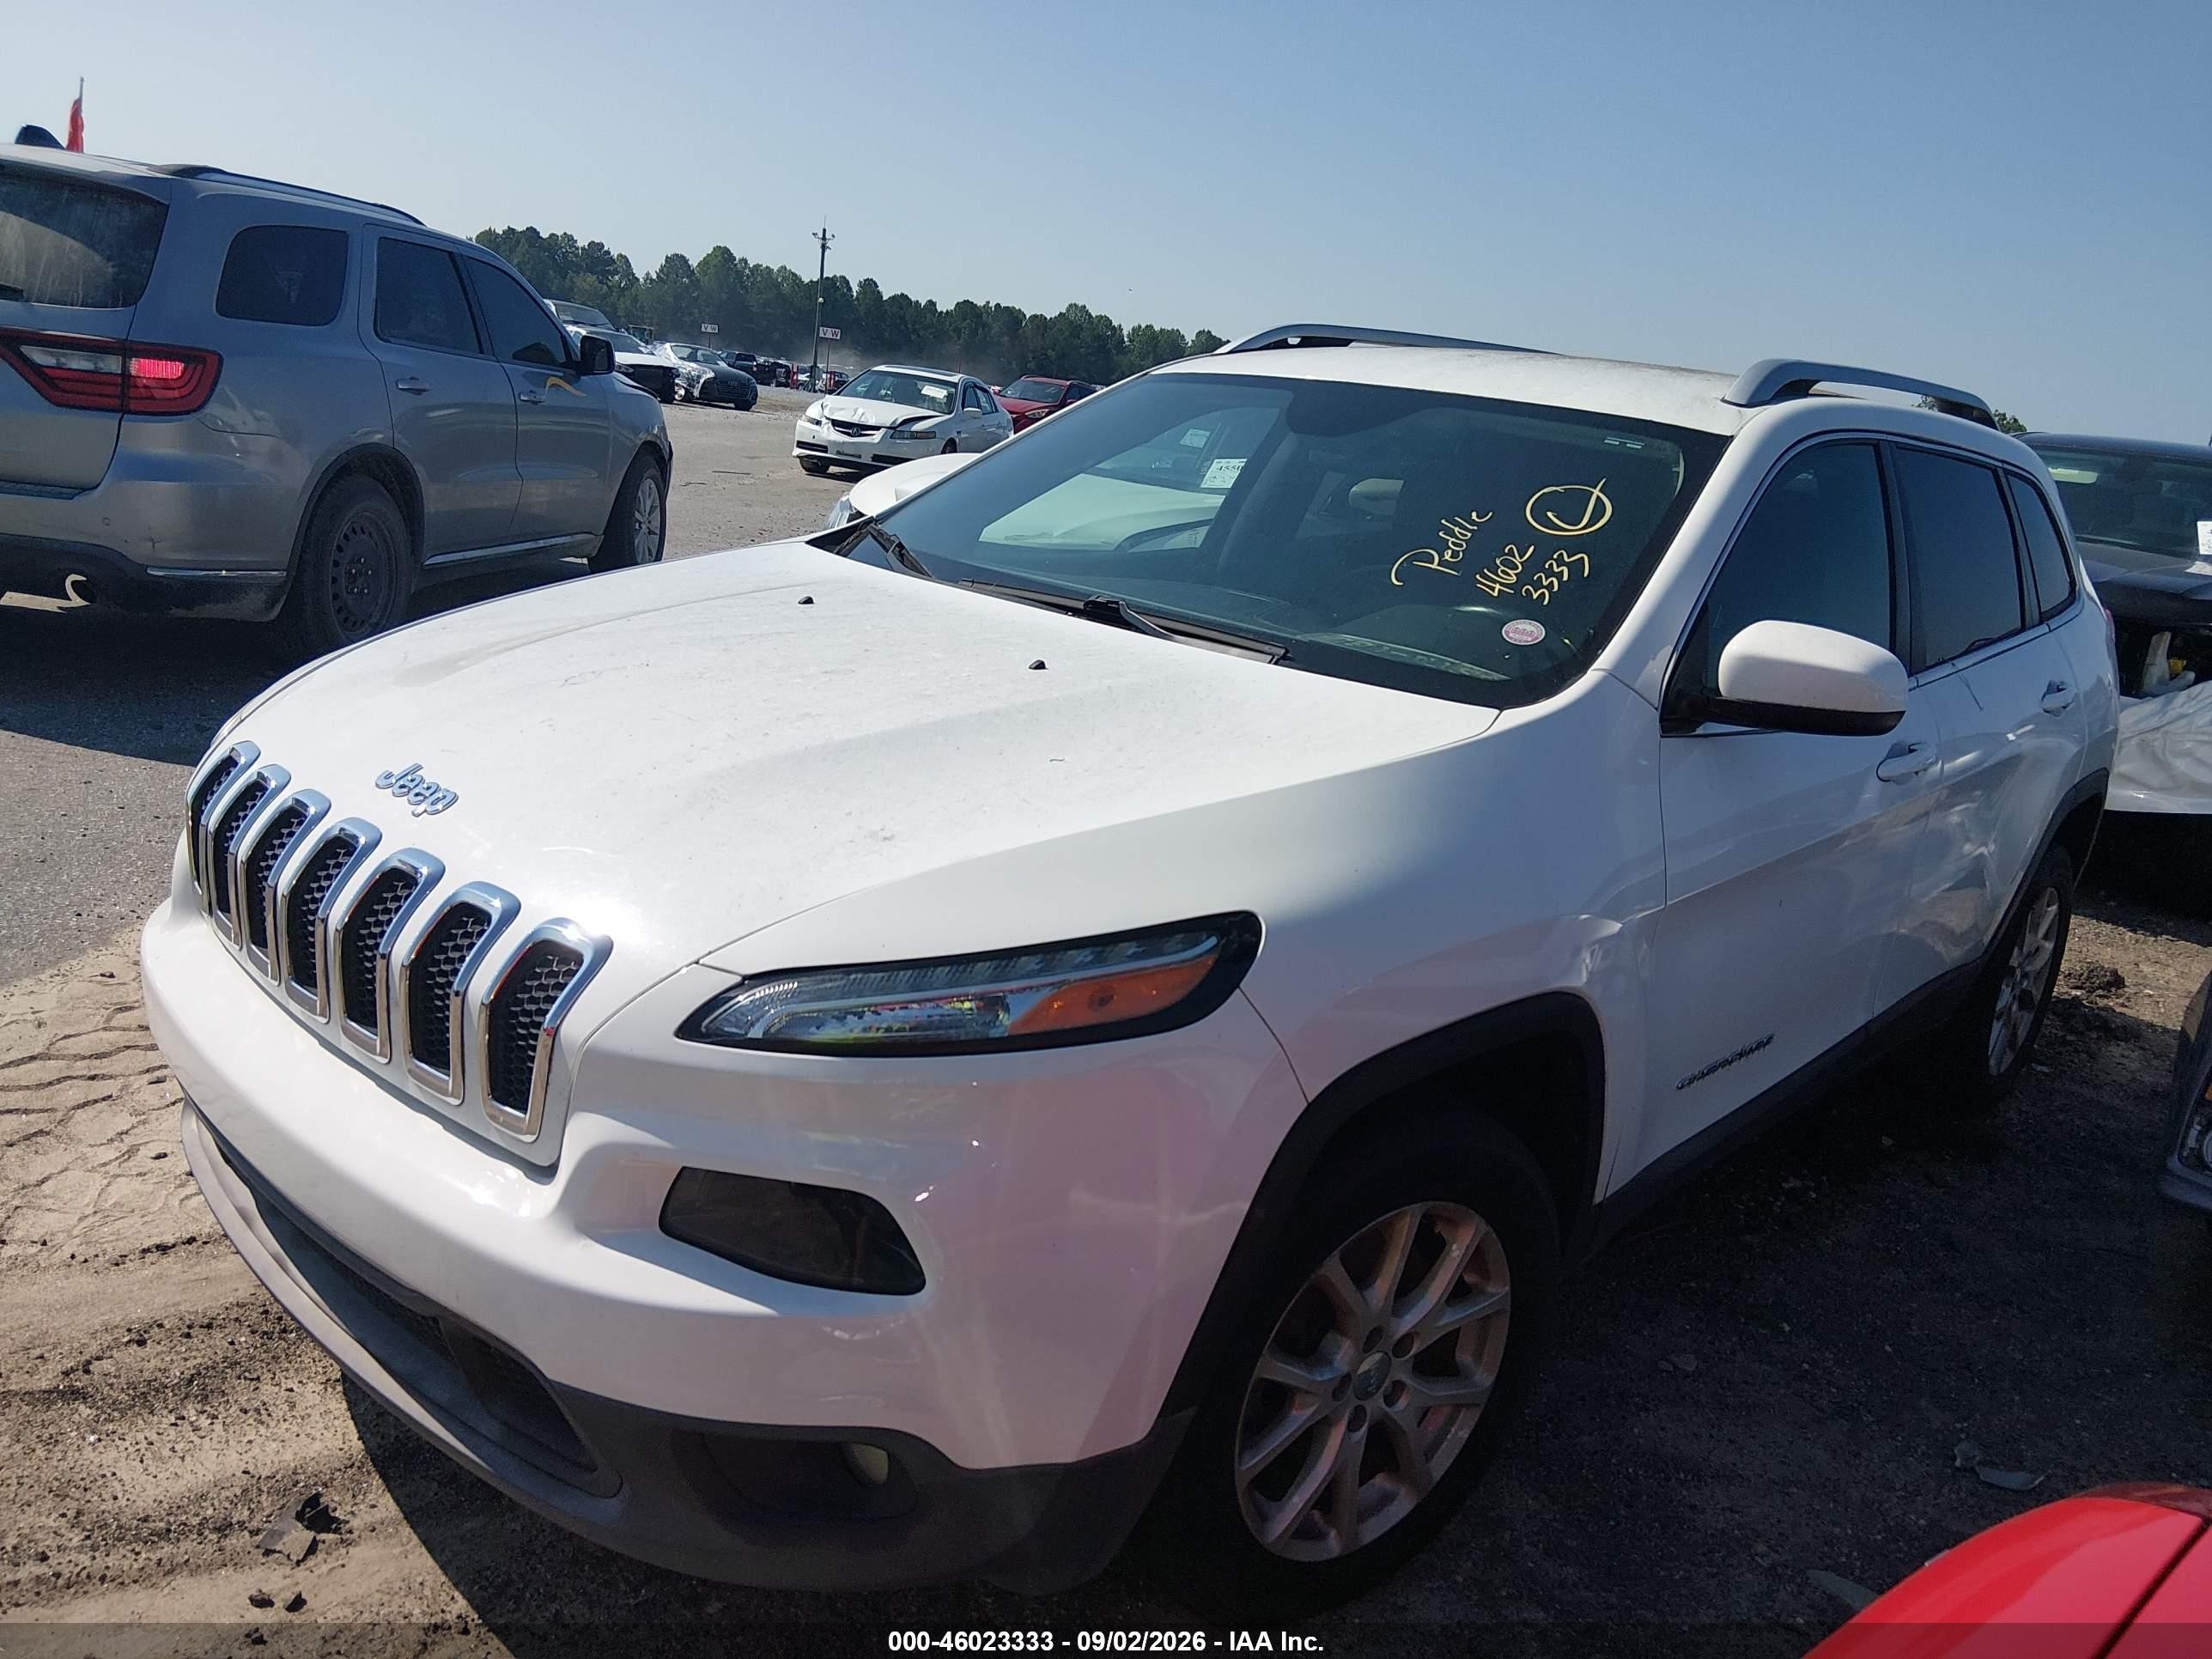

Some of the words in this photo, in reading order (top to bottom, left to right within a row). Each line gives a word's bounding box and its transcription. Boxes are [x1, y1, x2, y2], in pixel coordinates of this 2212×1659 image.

[1390, 509, 1493, 586] Peddle
[1474, 544, 1535, 599] 4602
[1522, 550, 1589, 606] 3333
[375, 763, 459, 817] Jeep
